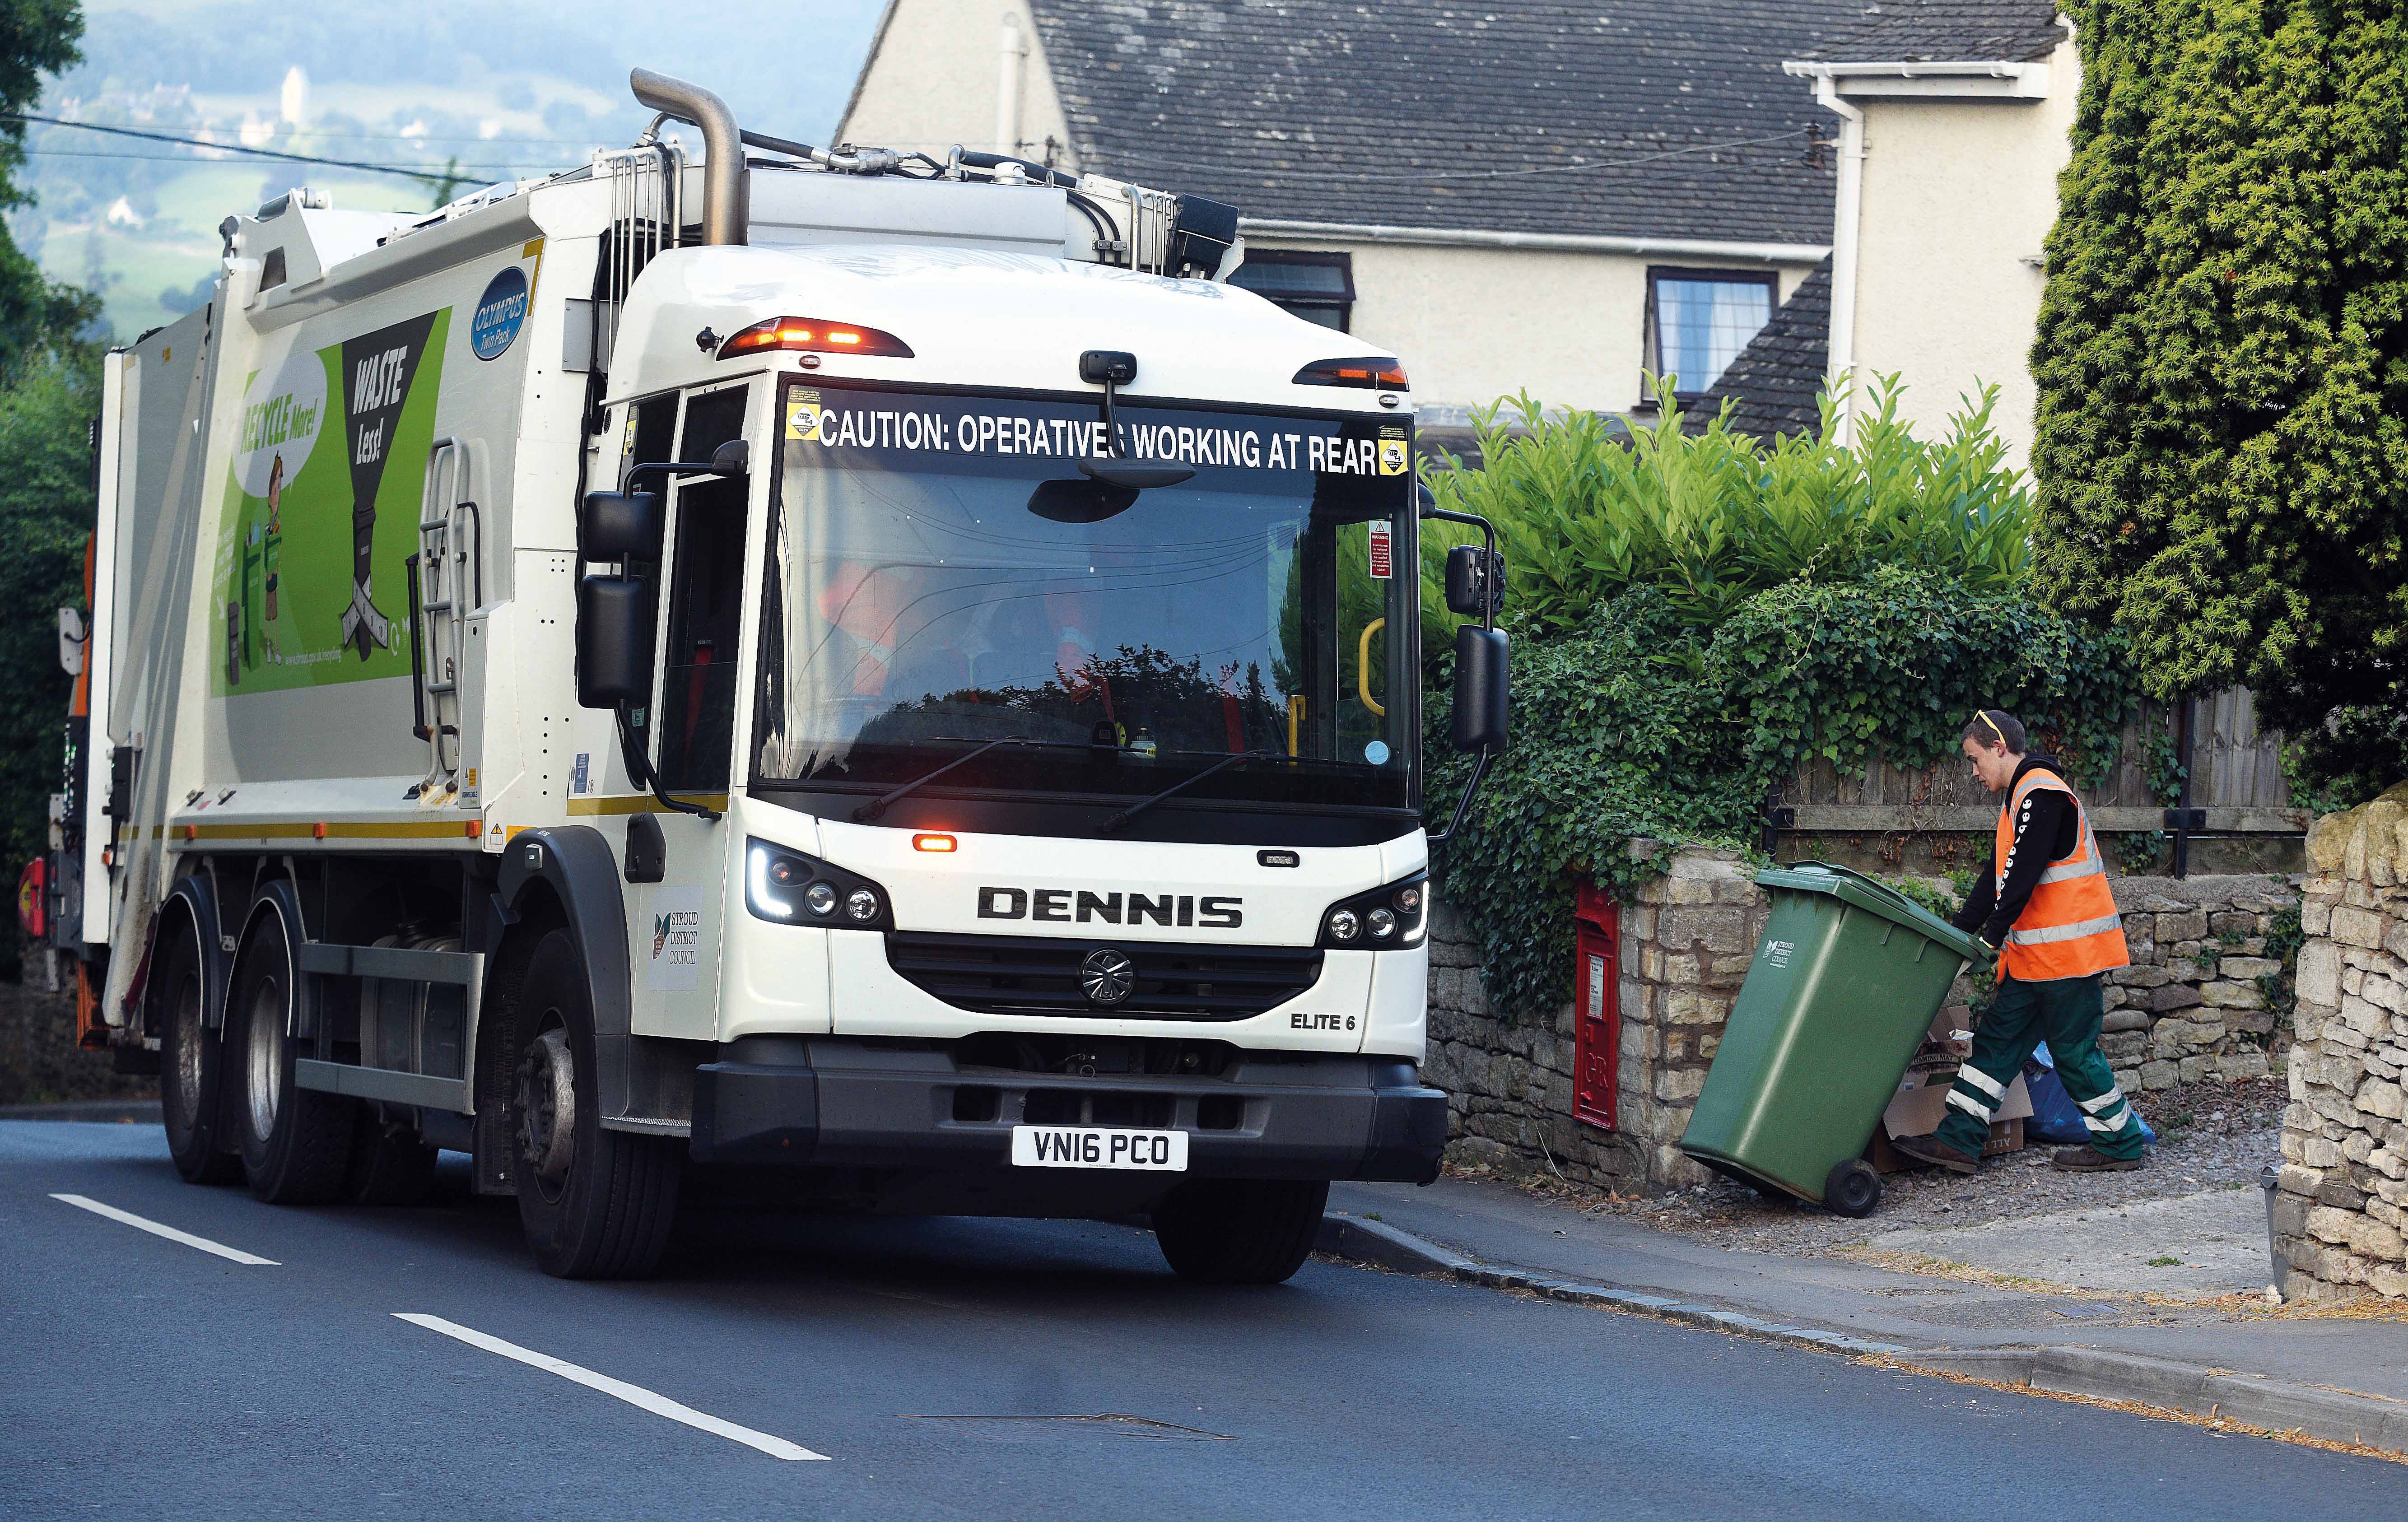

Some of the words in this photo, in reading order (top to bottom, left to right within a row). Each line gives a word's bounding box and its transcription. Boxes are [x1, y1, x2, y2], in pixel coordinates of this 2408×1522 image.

[475, 293, 525, 332] OLYMPUS
[481, 332, 494, 351] Twin
[494, 326, 510, 347] Pack
[353, 345, 408, 415] WASTE
[240, 393, 293, 455] RECYCLE
[289, 398, 318, 441] More!
[356, 417, 384, 465] Less!
[818, 409, 950, 451] CAUTION:
[1132, 424, 1260, 468] WORKING
[1267, 433, 1300, 470] AT
[1309, 435, 1376, 476] REAR
[977, 886, 1243, 928] DENNIS
[671, 912, 698, 926] STROUD
[671, 931, 697, 945] DISTRICT
[1777, 941, 1794, 949] STROUD
[669, 950, 695, 964] COUNCIL
[1771, 955, 1788, 964] COUNCIL
[1775, 948, 1792, 956] DISTRICT
[1291, 1013, 1341, 1030] ELITE
[1346, 1015, 1355, 1030] 6
[1914, 1055, 1939, 1063] GAMING
[1034, 1132, 1100, 1163] VN16
[1110, 1134, 1169, 1164] PCO
[1991, 1138, 2011, 1149] ALL
